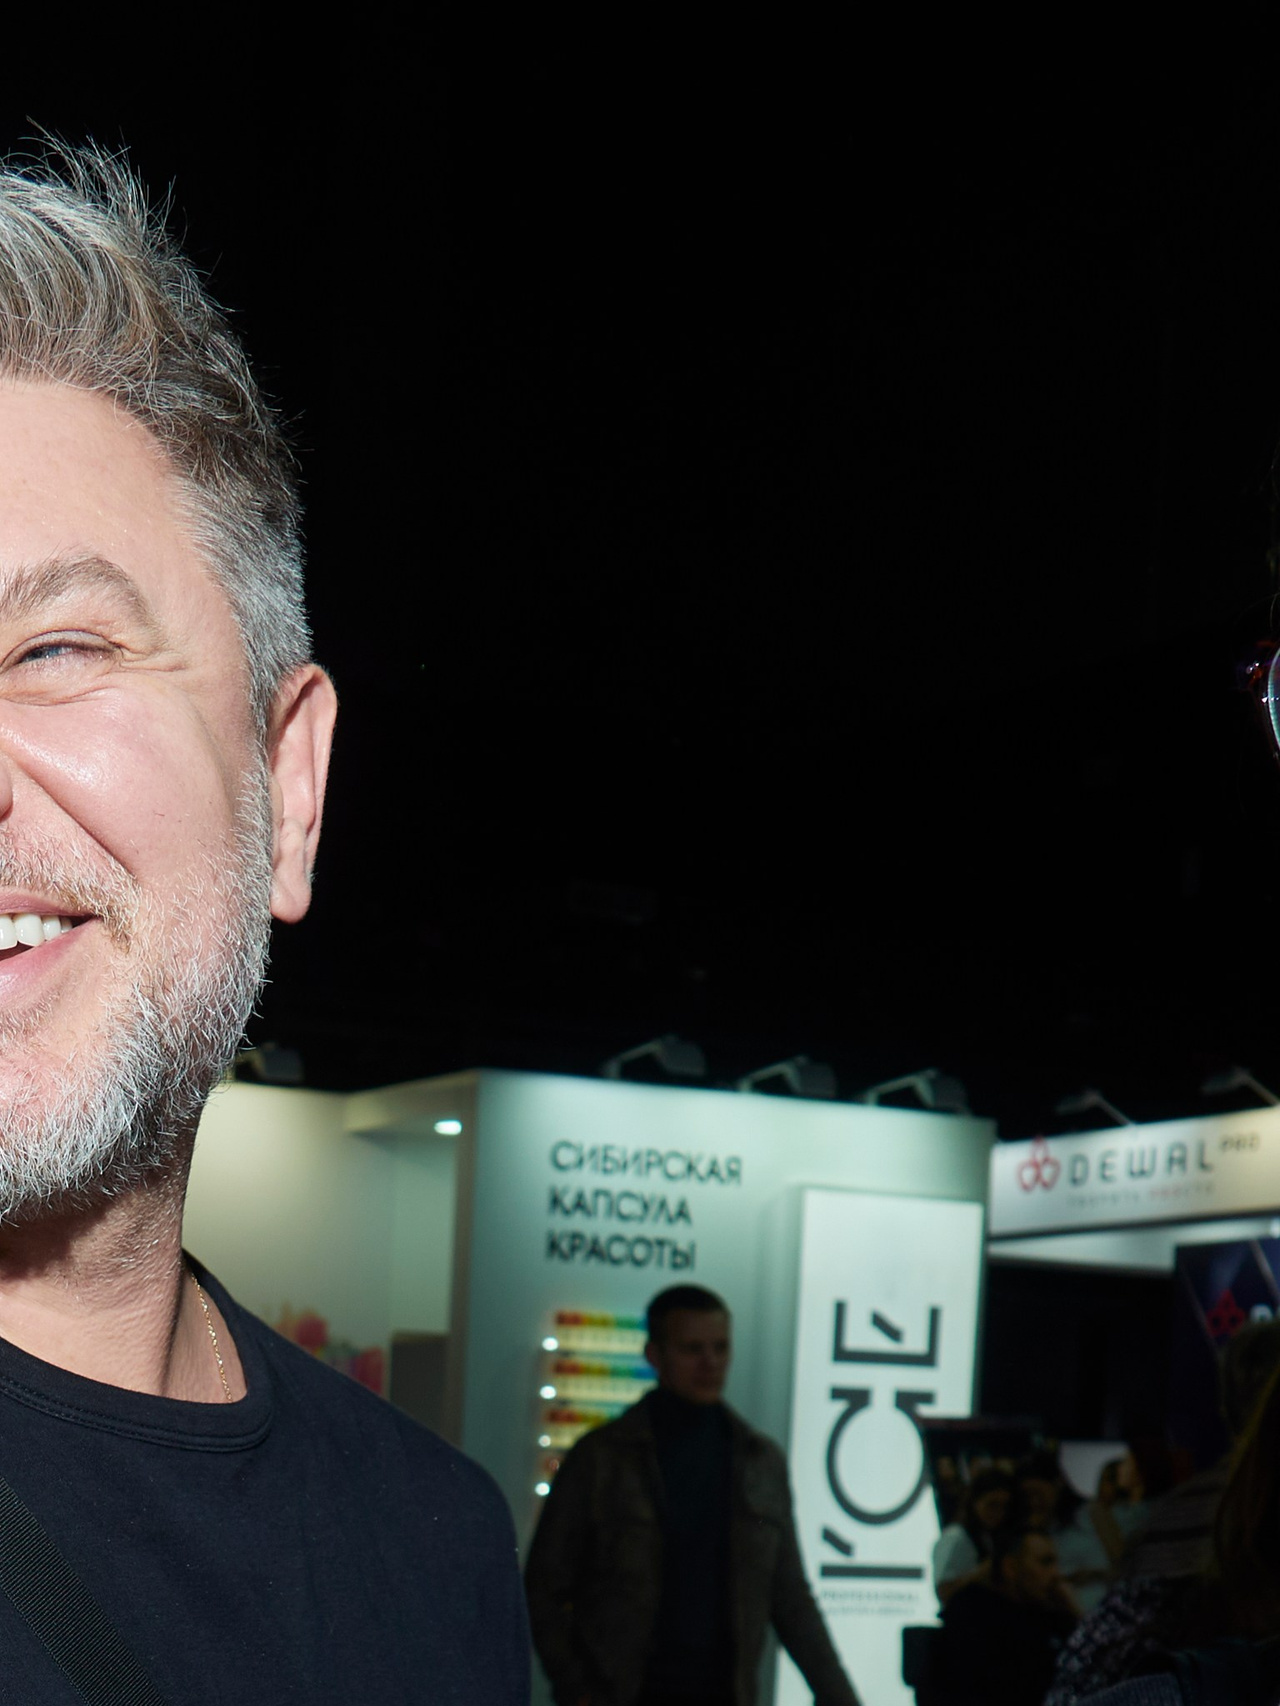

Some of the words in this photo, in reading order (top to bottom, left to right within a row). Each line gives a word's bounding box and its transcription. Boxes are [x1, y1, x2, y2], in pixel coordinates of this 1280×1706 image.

[549, 1139, 742, 1186] СИБИРСКАЯ
[1069, 1140, 1214, 1188] DEWAL
[548, 1185, 693, 1228] КАПСУЛА
[545, 1229, 696, 1271] КРАСОТЫ
